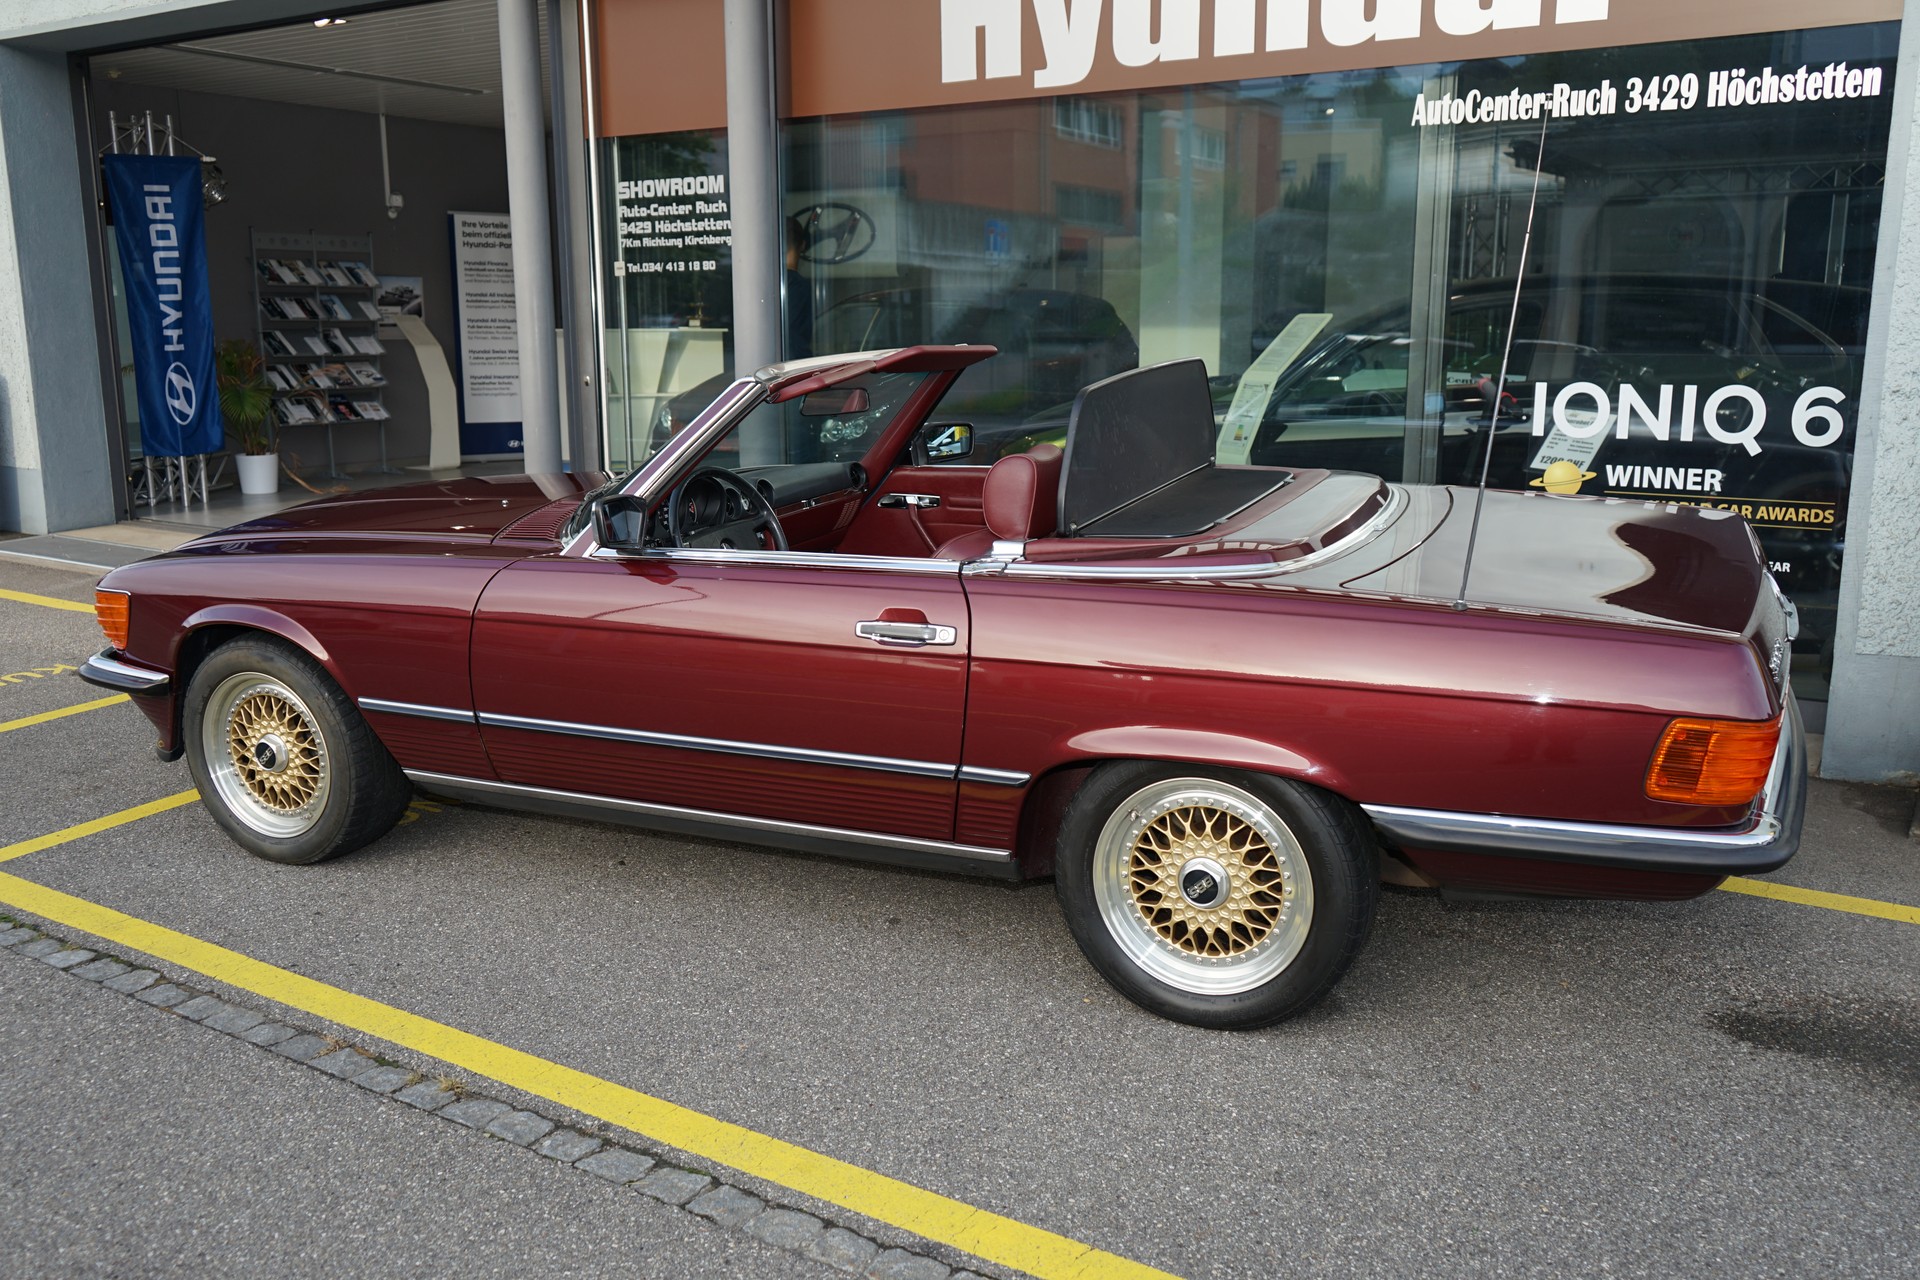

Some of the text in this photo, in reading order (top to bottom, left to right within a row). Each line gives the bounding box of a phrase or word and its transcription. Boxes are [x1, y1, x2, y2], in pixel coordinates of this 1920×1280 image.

[941, 0, 1608, 89] Hyun
[1624, 73, 1699, 113] 3429
[1707, 62, 1882, 108] Höchstetten
[618, 174, 725, 200] SHOWROOM
[619, 200, 728, 218] Auto-Center Ruch
[461, 220, 508, 229] Ihre Vorteile
[620, 218, 732, 235] 3429 Höchstetten
[462, 230, 483, 238] beim
[620, 234, 732, 249] 7Km Richtung Kirchberg
[462, 240, 513, 249] Hyundai-Par
[143, 183, 185, 352] HYUNDAI
[463, 260, 487, 268] Hyundai
[665, 261, 685, 272] 413
[688, 261, 701, 272] 18
[702, 260, 717, 271] 80
[465, 291, 488, 299] Hyundai
[468, 348, 491, 356] Hyundai
[1531, 381, 1846, 457] IONIQ 6
[1605, 464, 1723, 492] WINNER
[1717, 503, 1752, 521] CAR
[1755, 505, 1835, 524] AWARDS
[1768, 561, 1791, 573] EAR
[1187, 875, 1214, 899] BBS
